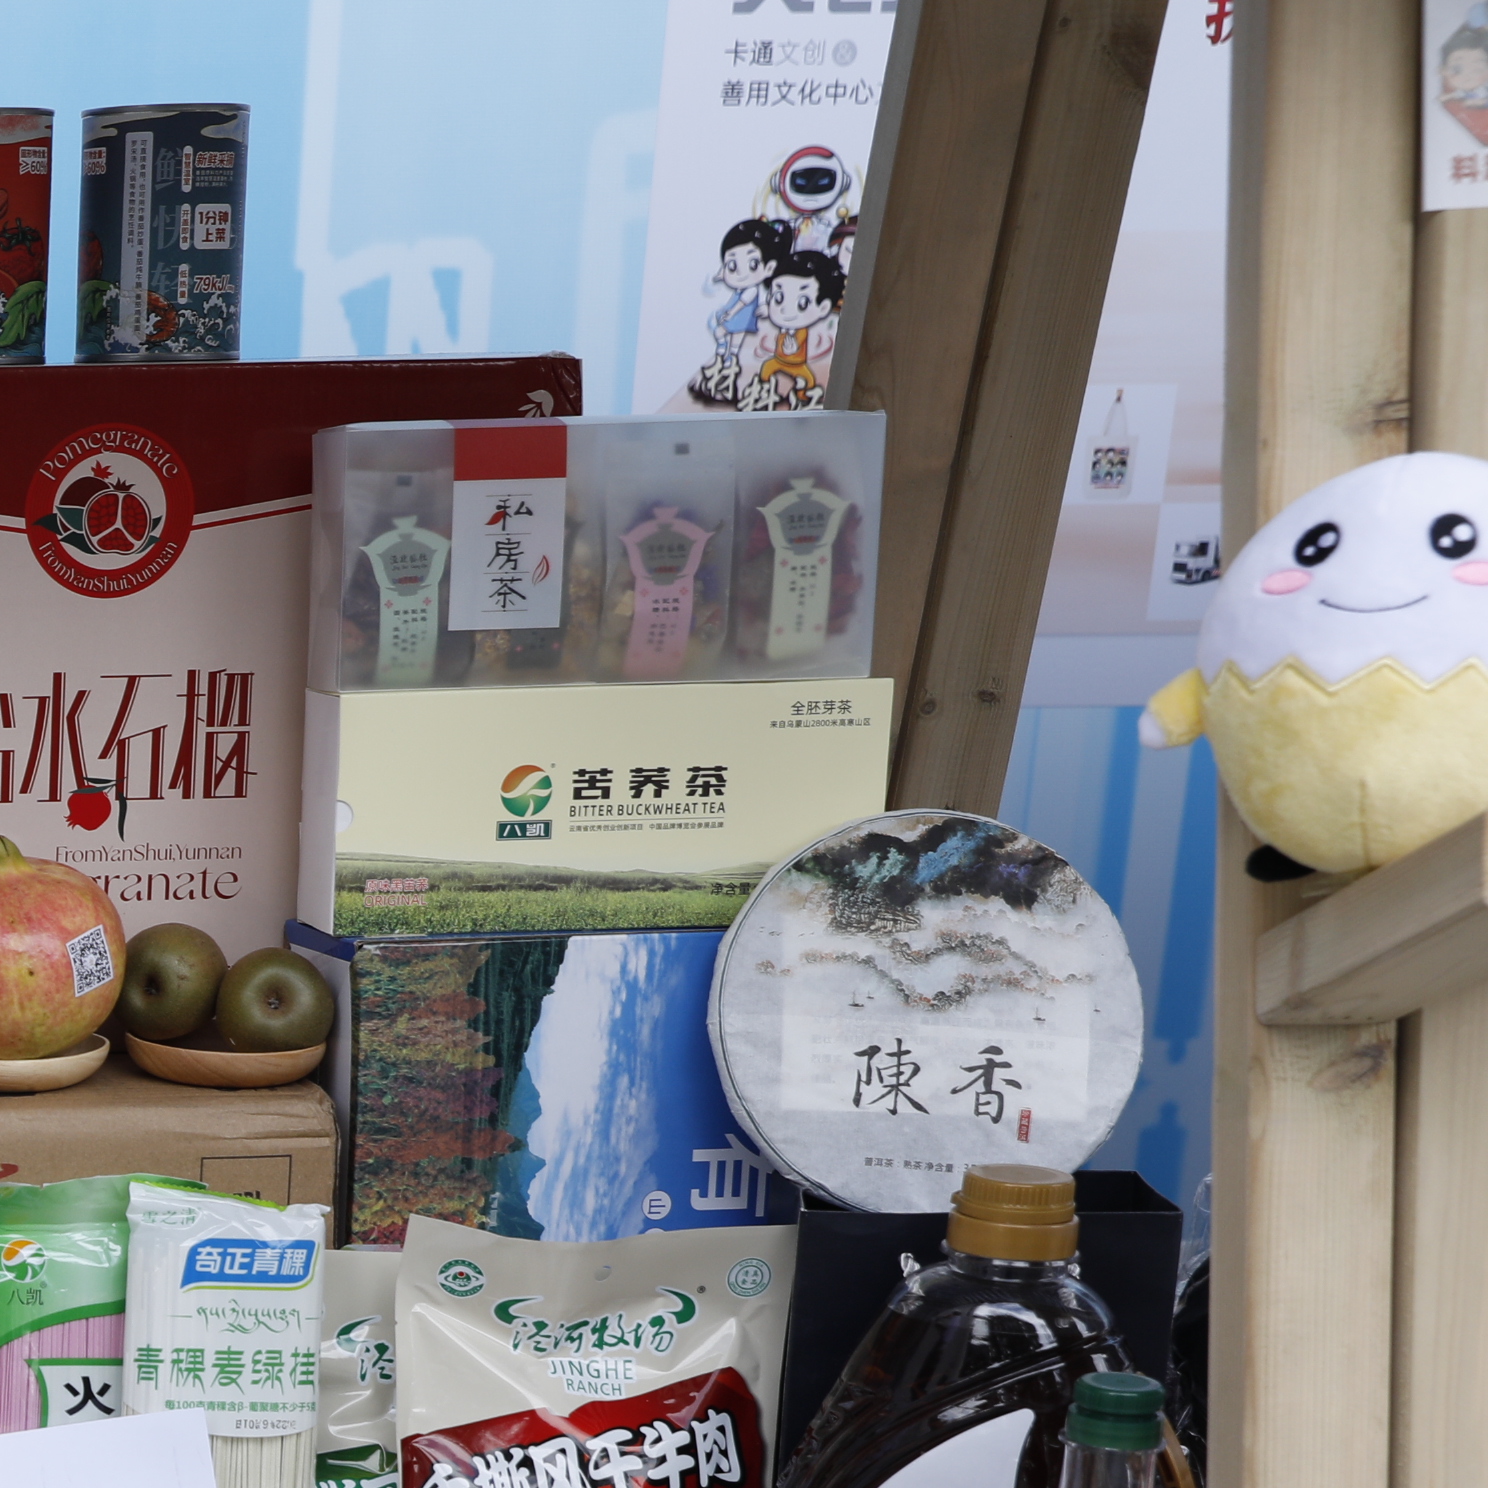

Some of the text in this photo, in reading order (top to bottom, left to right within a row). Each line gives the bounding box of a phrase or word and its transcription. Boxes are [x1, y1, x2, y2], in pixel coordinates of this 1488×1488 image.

[198, 211, 229, 226] 1分钟
[202, 228, 226, 243] 上菜
[39, 430, 178, 480] Pomegranate
[486, 497, 534, 609] 私房茶
[790, 700, 853, 716] 全胚芽茶
[769, 718, 871, 729] 来自乌蒙山2800米高寒山区
[571, 766, 728, 800] 苦荞茶
[569, 802, 726, 817] BITTER BUCKWHEAT TEA
[364, 895, 428, 908] ORIGINAL
[853, 1037, 1024, 1124] 陳香
[195, 1246, 308, 1276] 奇正青稞
[6, 1285, 44, 1307] 八凯
[513, 1314, 674, 1353] 泾河牧场
[549, 1360, 633, 1380] JINGHE
[63, 1375, 115, 1417] 火
[566, 1379, 622, 1396] RANCH
